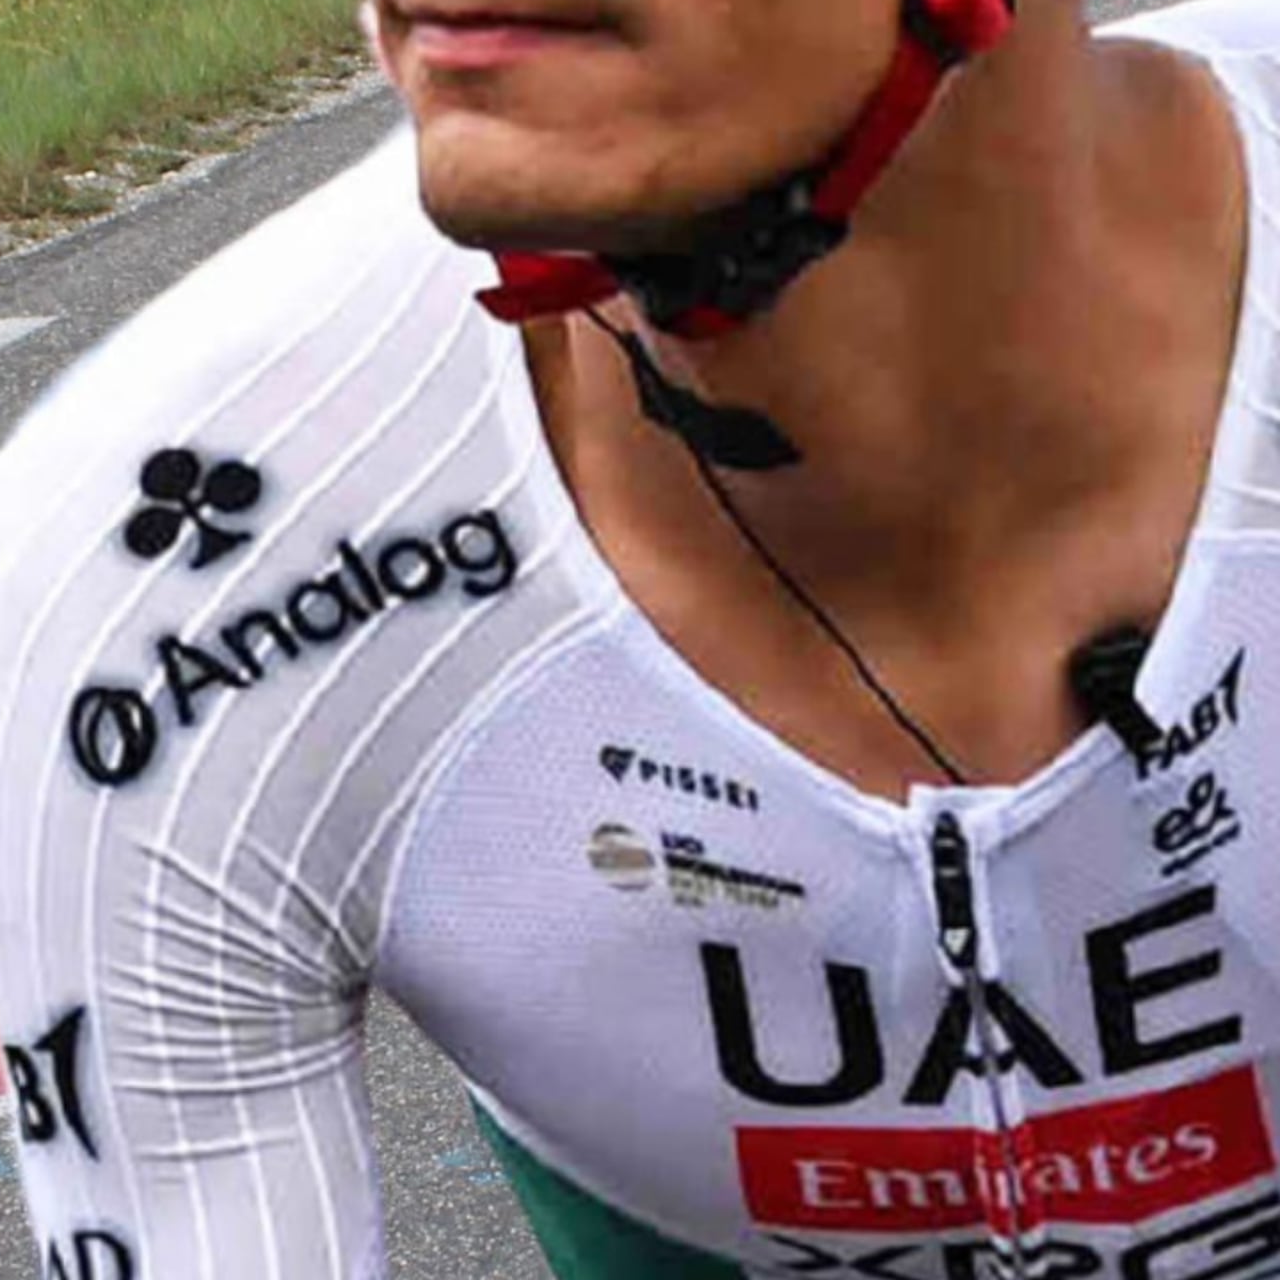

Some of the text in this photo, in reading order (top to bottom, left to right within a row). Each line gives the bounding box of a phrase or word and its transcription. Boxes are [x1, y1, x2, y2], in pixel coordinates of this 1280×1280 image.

[158, 509, 517, 725] Analog
[699, 884, 1242, 1107] UAE
[794, 1124, 1218, 1209] Emirates
